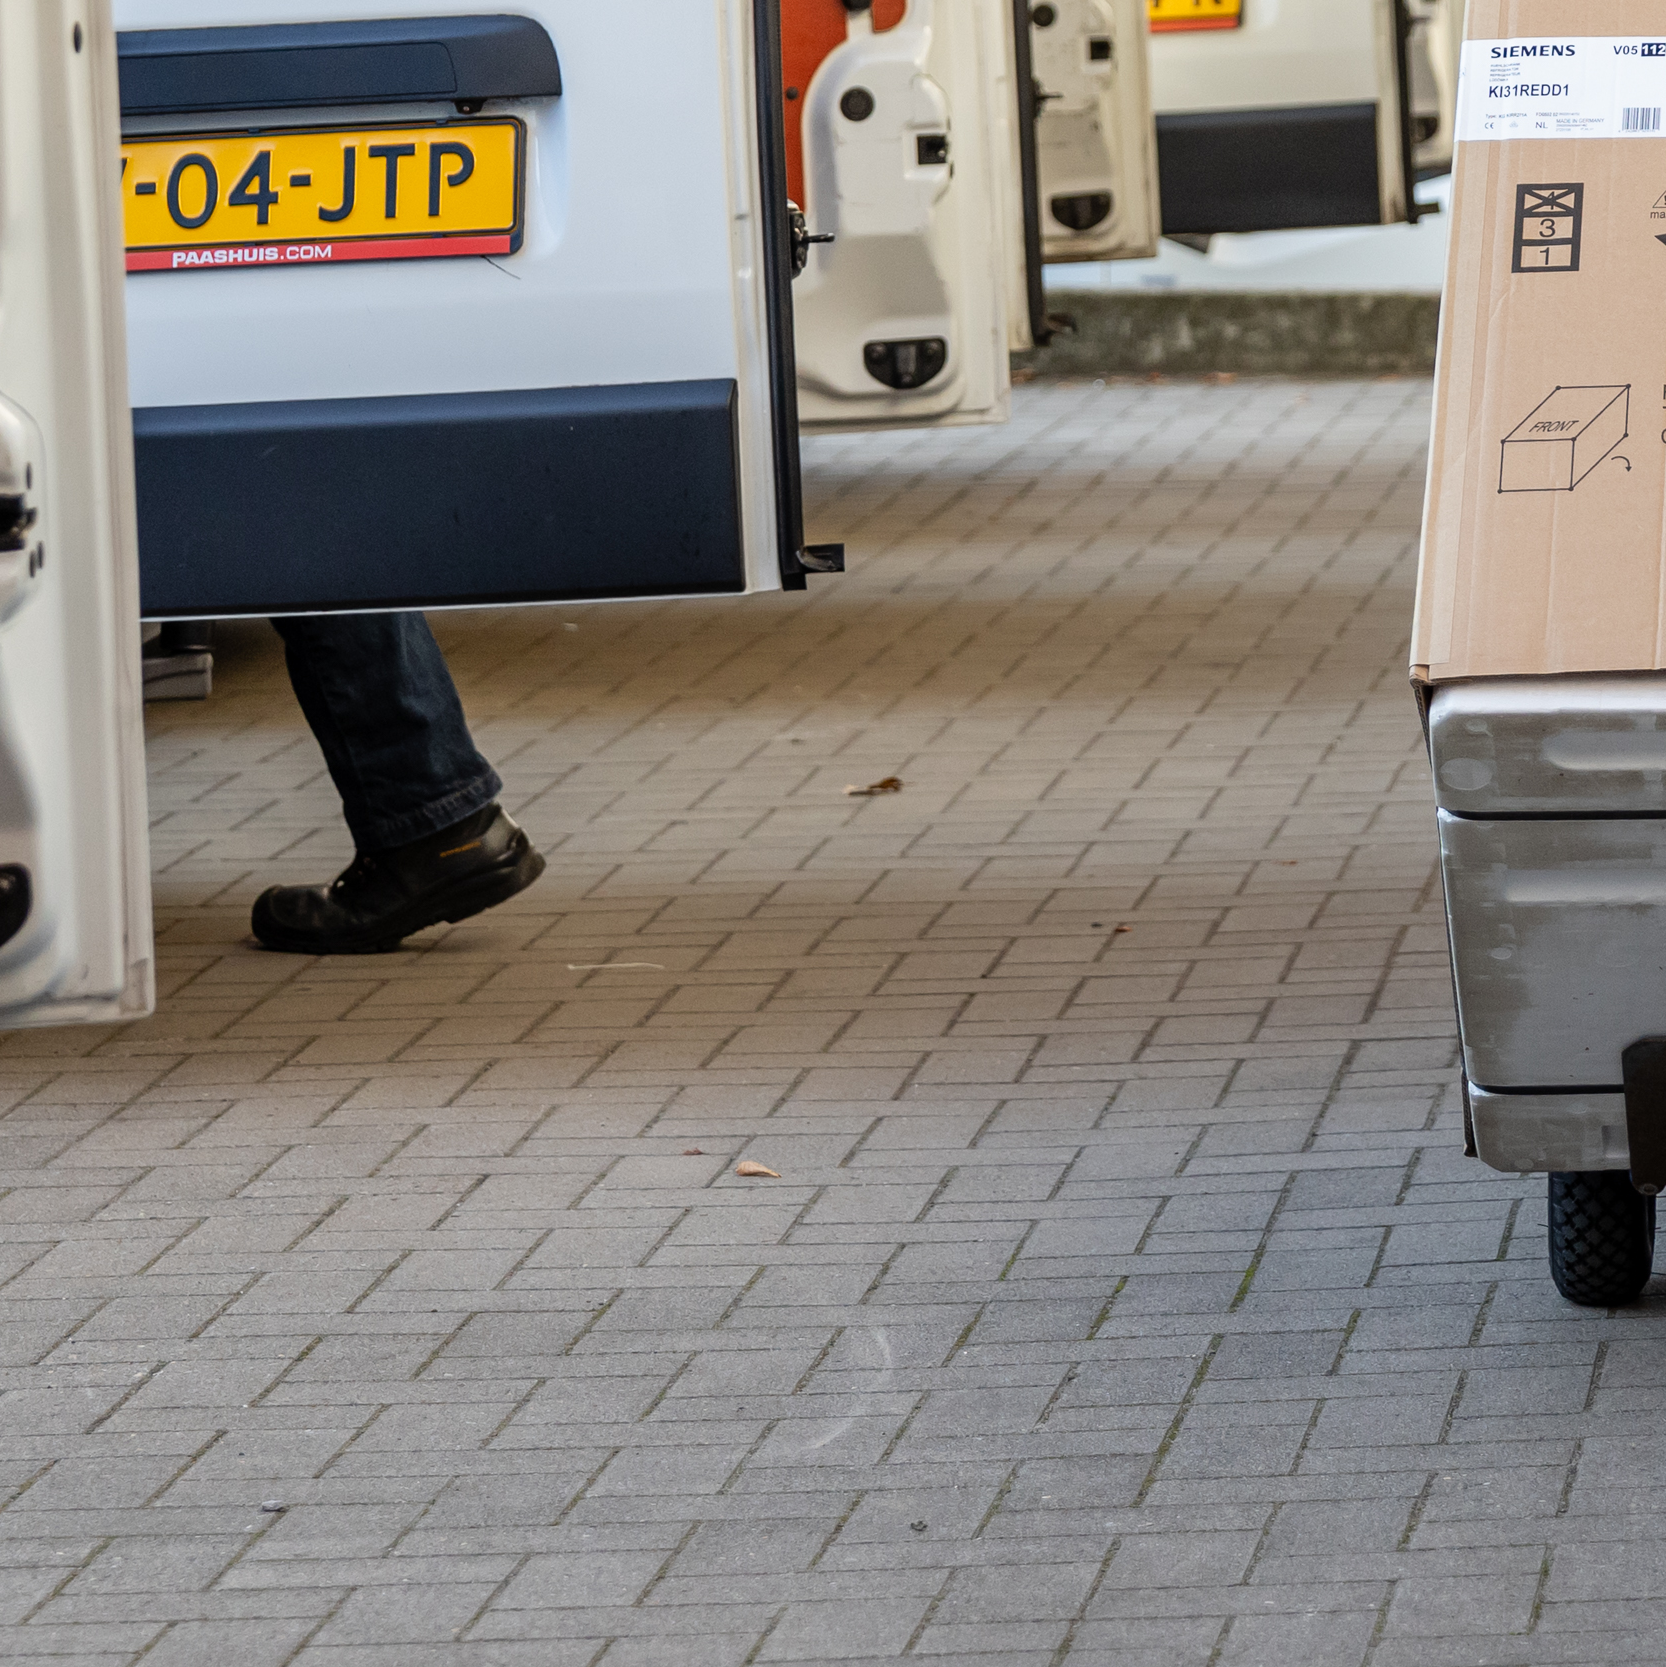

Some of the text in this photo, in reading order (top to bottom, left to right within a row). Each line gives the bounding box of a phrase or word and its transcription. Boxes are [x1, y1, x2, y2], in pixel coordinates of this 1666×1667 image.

[1490, 44, 1576, 59] SIEMENS
[1613, 44, 1666, 55] V05 112
[1488, 84, 1569, 98] KI31REDD1
[1535, 121, 1549, 129] NL
[122, 141, 475, 229] -04-JTP
[1539, 218, 1555, 238] 3
[172, 244, 332, 268] PAASHUIS.COM
[1539, 247, 1550, 266] 1
[1528, 419, 1579, 433] FRONT
